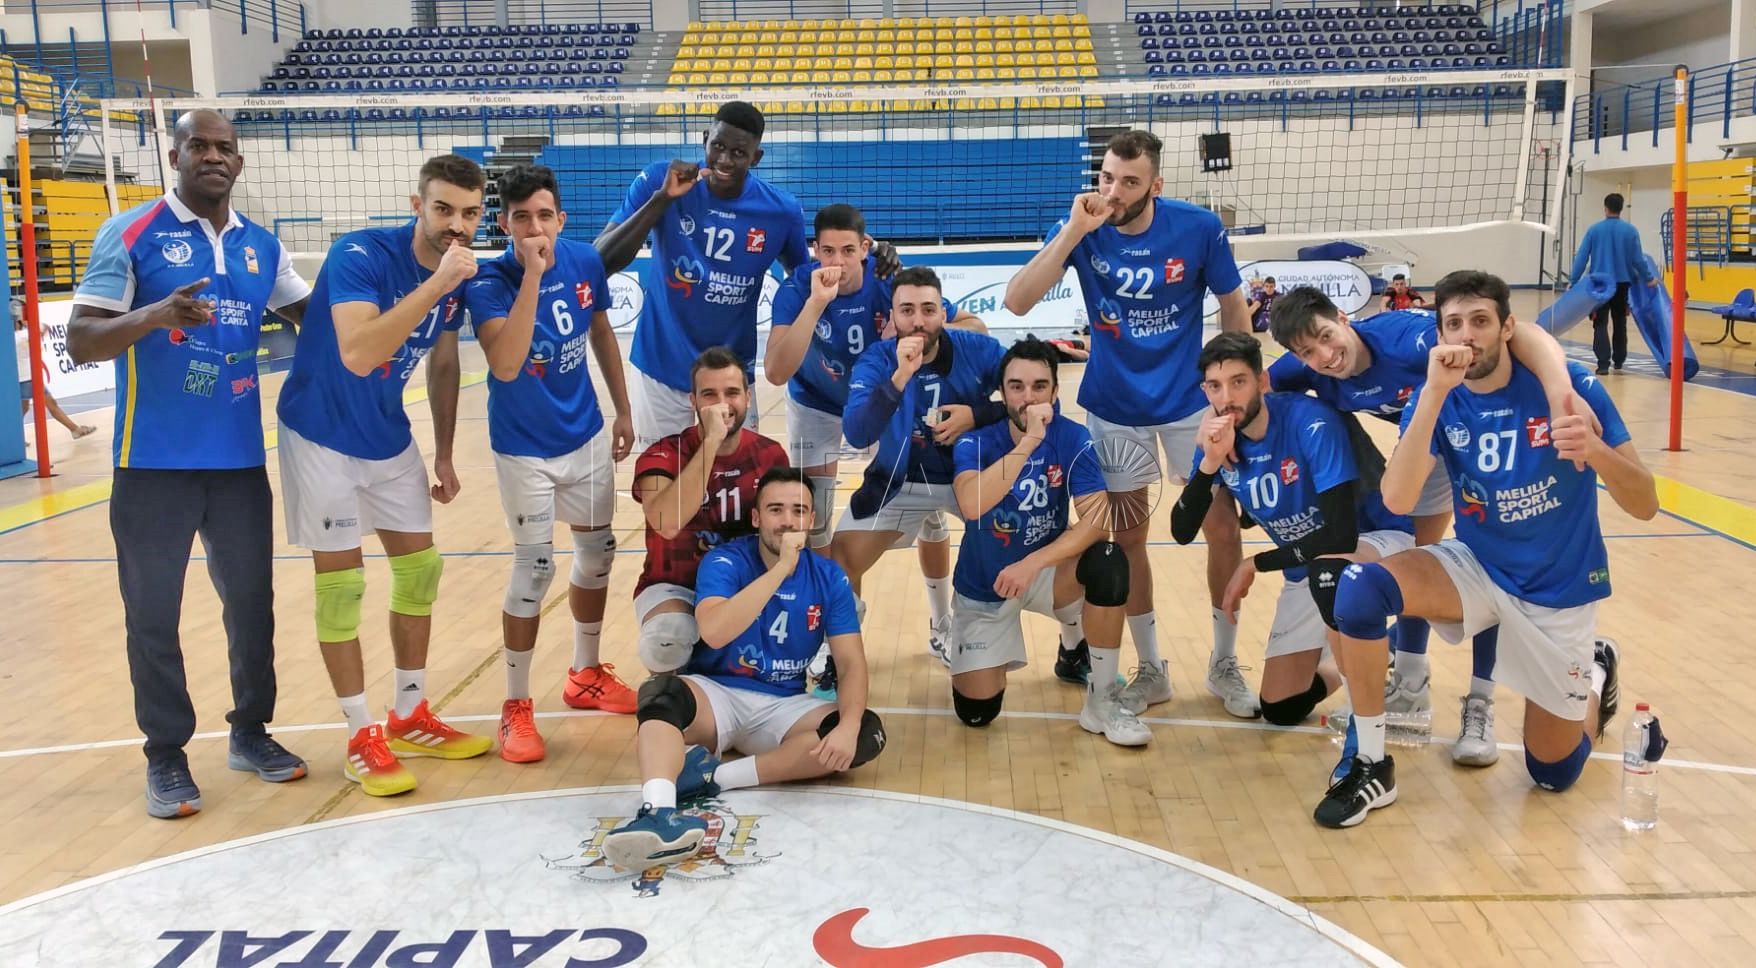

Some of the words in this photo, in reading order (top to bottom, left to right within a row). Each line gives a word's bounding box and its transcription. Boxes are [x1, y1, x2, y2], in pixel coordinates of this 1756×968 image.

[1268, 79, 1311, 87] rfevb.com
[1384, 75, 1427, 84] rfevb.com
[1500, 71, 1544, 80] rfevb.cm
[810, 90, 853, 99] rfevb.com
[924, 88, 967, 97] rfevb.com
[1038, 85, 1081, 94] rfevb.com
[1153, 82, 1196, 91] rfevb.com
[132, 98, 174, 107] rfevom
[243, 97, 286, 106] rfevb.com
[356, 96, 399, 105] rfevb.com
[583, 93, 625, 102] rfevb.com
[696, 92, 738, 101] rfevb.com
[703, 226, 735, 262] 12
[709, 270, 755, 287] MELILLA
[1116, 267, 1154, 299] 22
[707, 282, 746, 297] SPORT
[1281, 283, 1361, 298] MILLA
[220, 299, 251, 311] MELILLA
[1128, 303, 1180, 318] MELILLA
[551, 299, 573, 336] 6
[1128, 316, 1171, 327] SPORT
[1131, 321, 1180, 338] CAPITAL
[847, 324, 864, 354] 9
[924, 382, 940, 409] 7
[1477, 430, 1518, 472] 87
[1018, 475, 1049, 511] 28
[1246, 472, 1279, 509] 10
[1495, 475, 1558, 501] MELILLA
[715, 486, 741, 522] 11
[1497, 490, 1549, 513] SPORT
[1499, 497, 1562, 523] CAPITAL
[1268, 506, 1320, 529] MELILLA
[1273, 518, 1316, 535] SPORT
[768, 609, 789, 645] 4
[156, 928, 650, 968] CAPITAL
